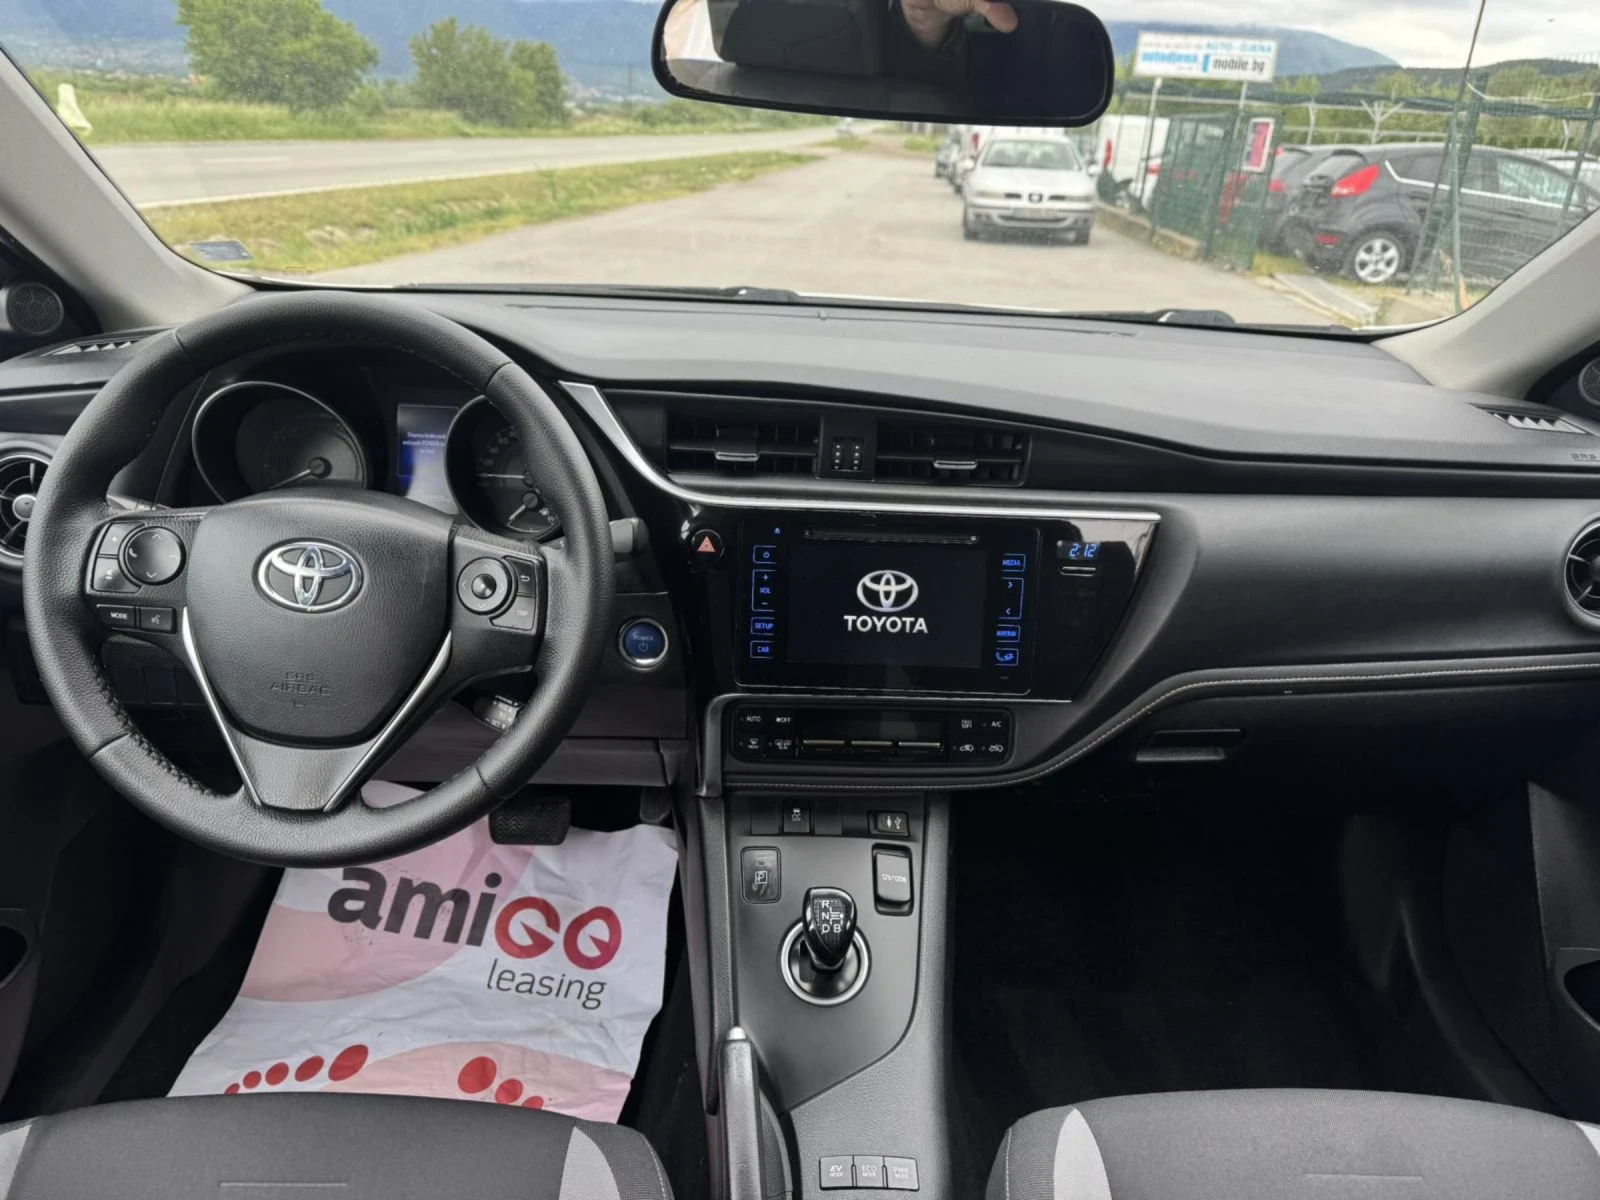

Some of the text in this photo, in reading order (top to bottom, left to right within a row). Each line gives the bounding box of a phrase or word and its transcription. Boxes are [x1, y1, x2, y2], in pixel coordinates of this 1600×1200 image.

[1212, 58, 1265, 74] mobile.bg
[1069, 543, 1098, 558] 2:12
[110, 612, 128, 620] MODE
[755, 622, 774, 630] SETUP
[843, 615, 929, 634] TOYOTA
[632, 634, 653, 642] POWER
[757, 645, 770, 653] CAR
[991, 720, 1002, 728] A/C
[821, 900, 830, 909] R
[821, 912, 830, 921] N
[821, 924, 842, 934] D B
[486, 958, 607, 1010] leasing
